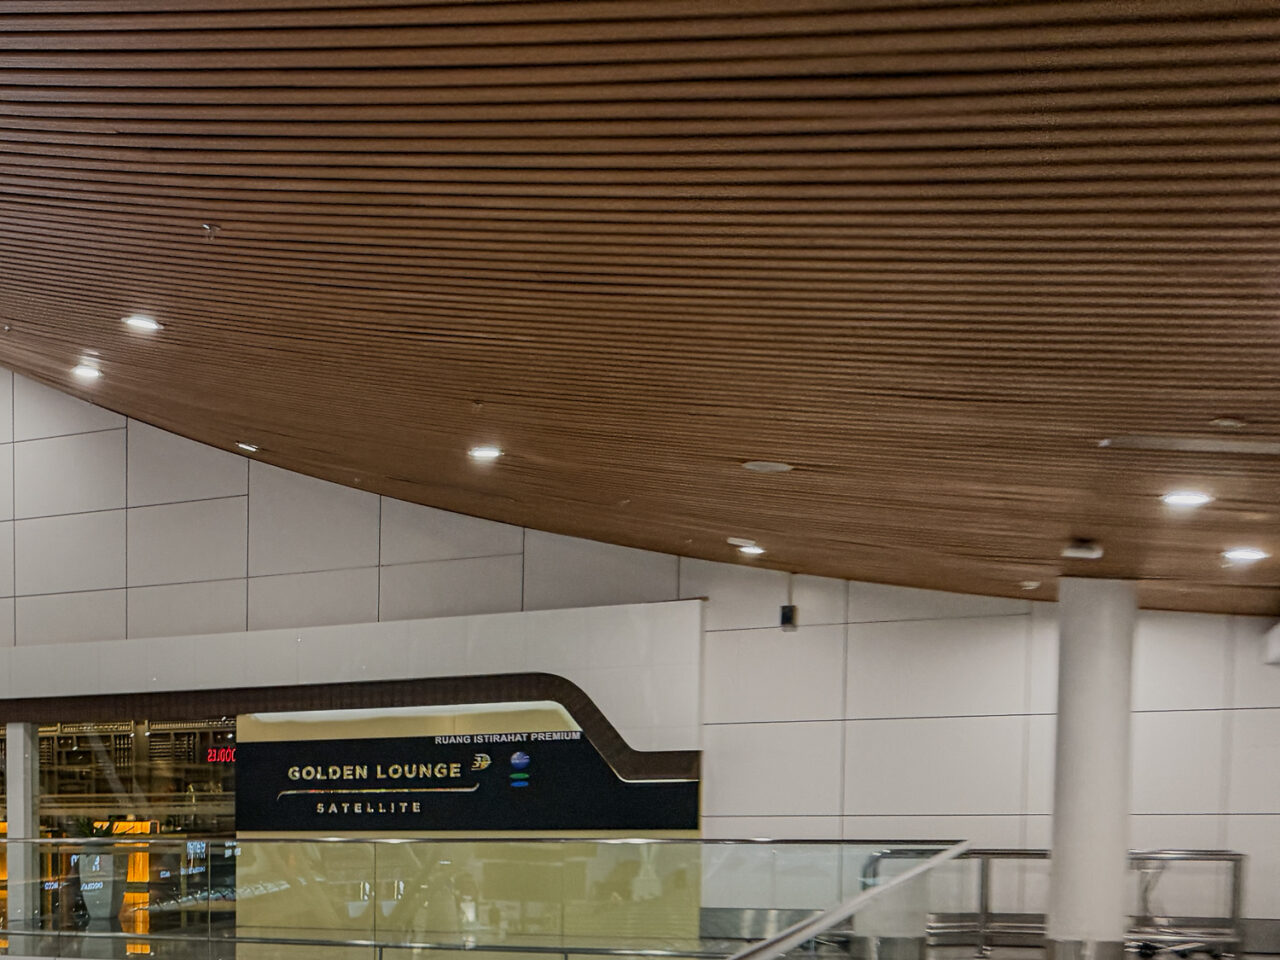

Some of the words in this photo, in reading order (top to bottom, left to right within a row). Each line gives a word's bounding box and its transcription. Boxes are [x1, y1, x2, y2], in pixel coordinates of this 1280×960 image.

[434, 734, 471, 745] RUANG
[473, 732, 528, 744] ISTIRAHAT
[530, 730, 581, 742] PREMIUM
[287, 764, 368, 781] GOLDEN
[376, 762, 461, 779] LOUNGE
[316, 801, 422, 814] SATELLITE
